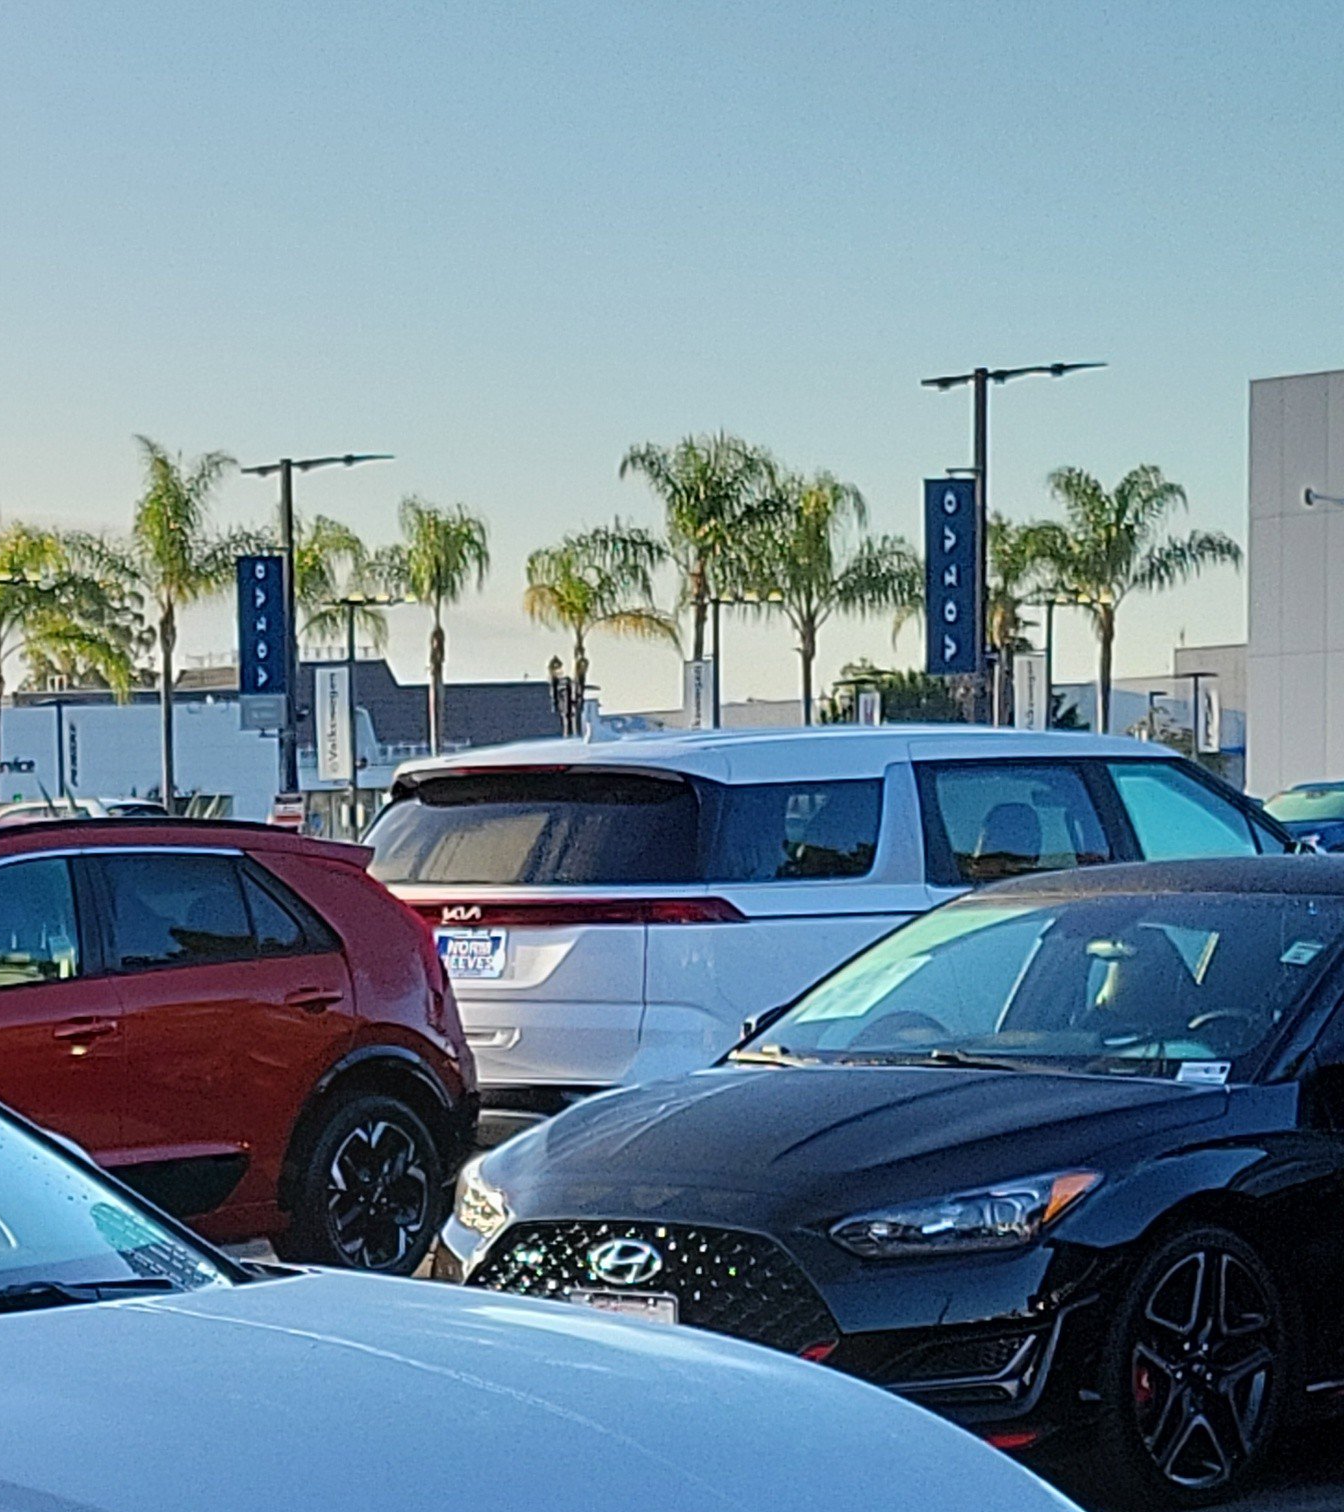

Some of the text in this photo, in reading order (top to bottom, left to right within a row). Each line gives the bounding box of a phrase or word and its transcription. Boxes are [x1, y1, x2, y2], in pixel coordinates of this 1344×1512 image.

[255, 563, 269, 687] VOLVO
[943, 490, 957, 662] VOLVO
[442, 906, 481, 920] KIA
